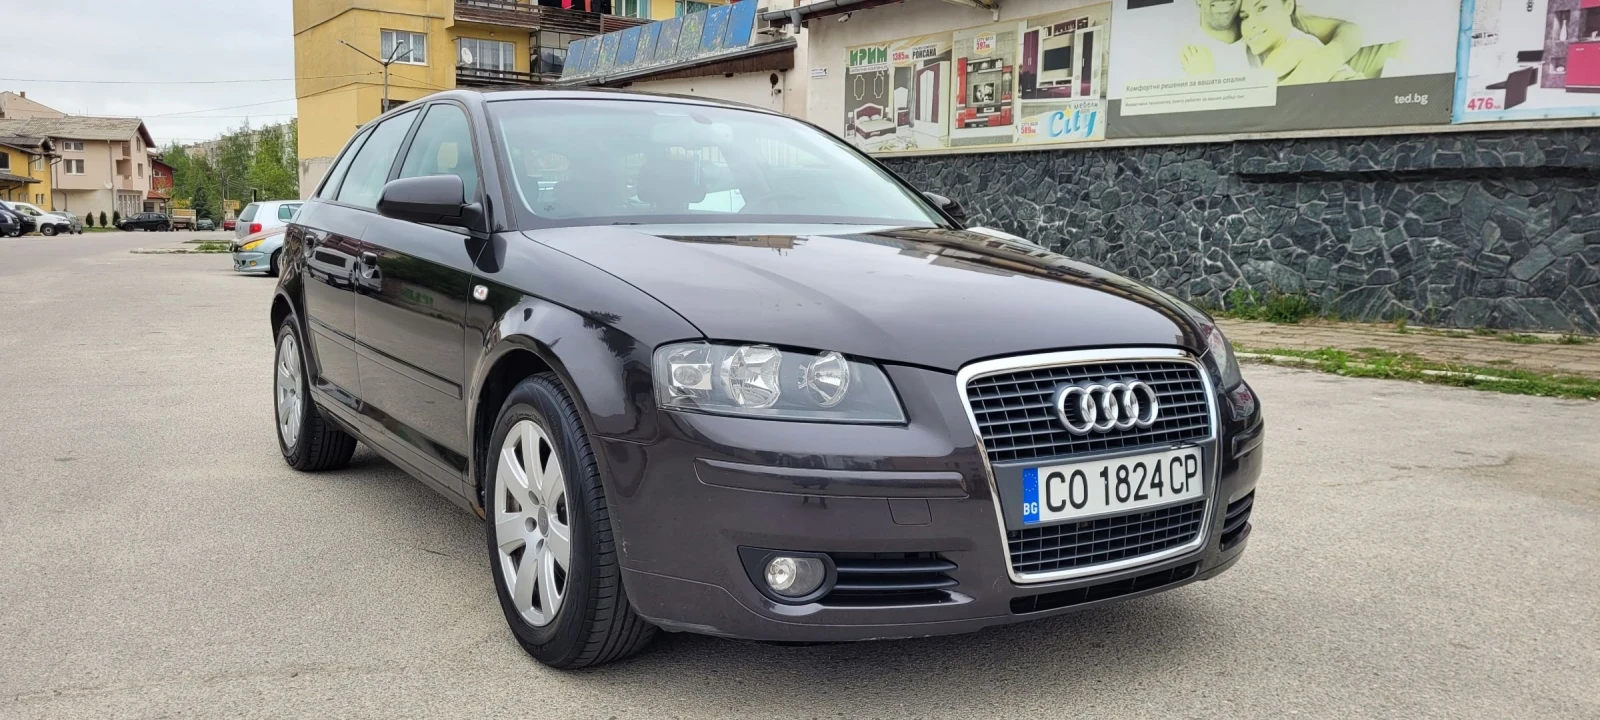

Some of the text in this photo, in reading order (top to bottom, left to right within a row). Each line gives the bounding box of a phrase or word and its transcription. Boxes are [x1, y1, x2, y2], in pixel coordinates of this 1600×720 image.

[850, 45, 888, 67] ИРИМ
[1126, 84, 1160, 92] Комфортни
[1161, 81, 1188, 90] решения
[1198, 78, 1222, 86] вашата
[1222, 76, 1246, 84] спалня
[1394, 93, 1428, 105] ted.bg
[1048, 109, 1097, 138] City
[1045, 453, 1198, 512] CO 1824 CP
[1023, 502, 1038, 515] BG
